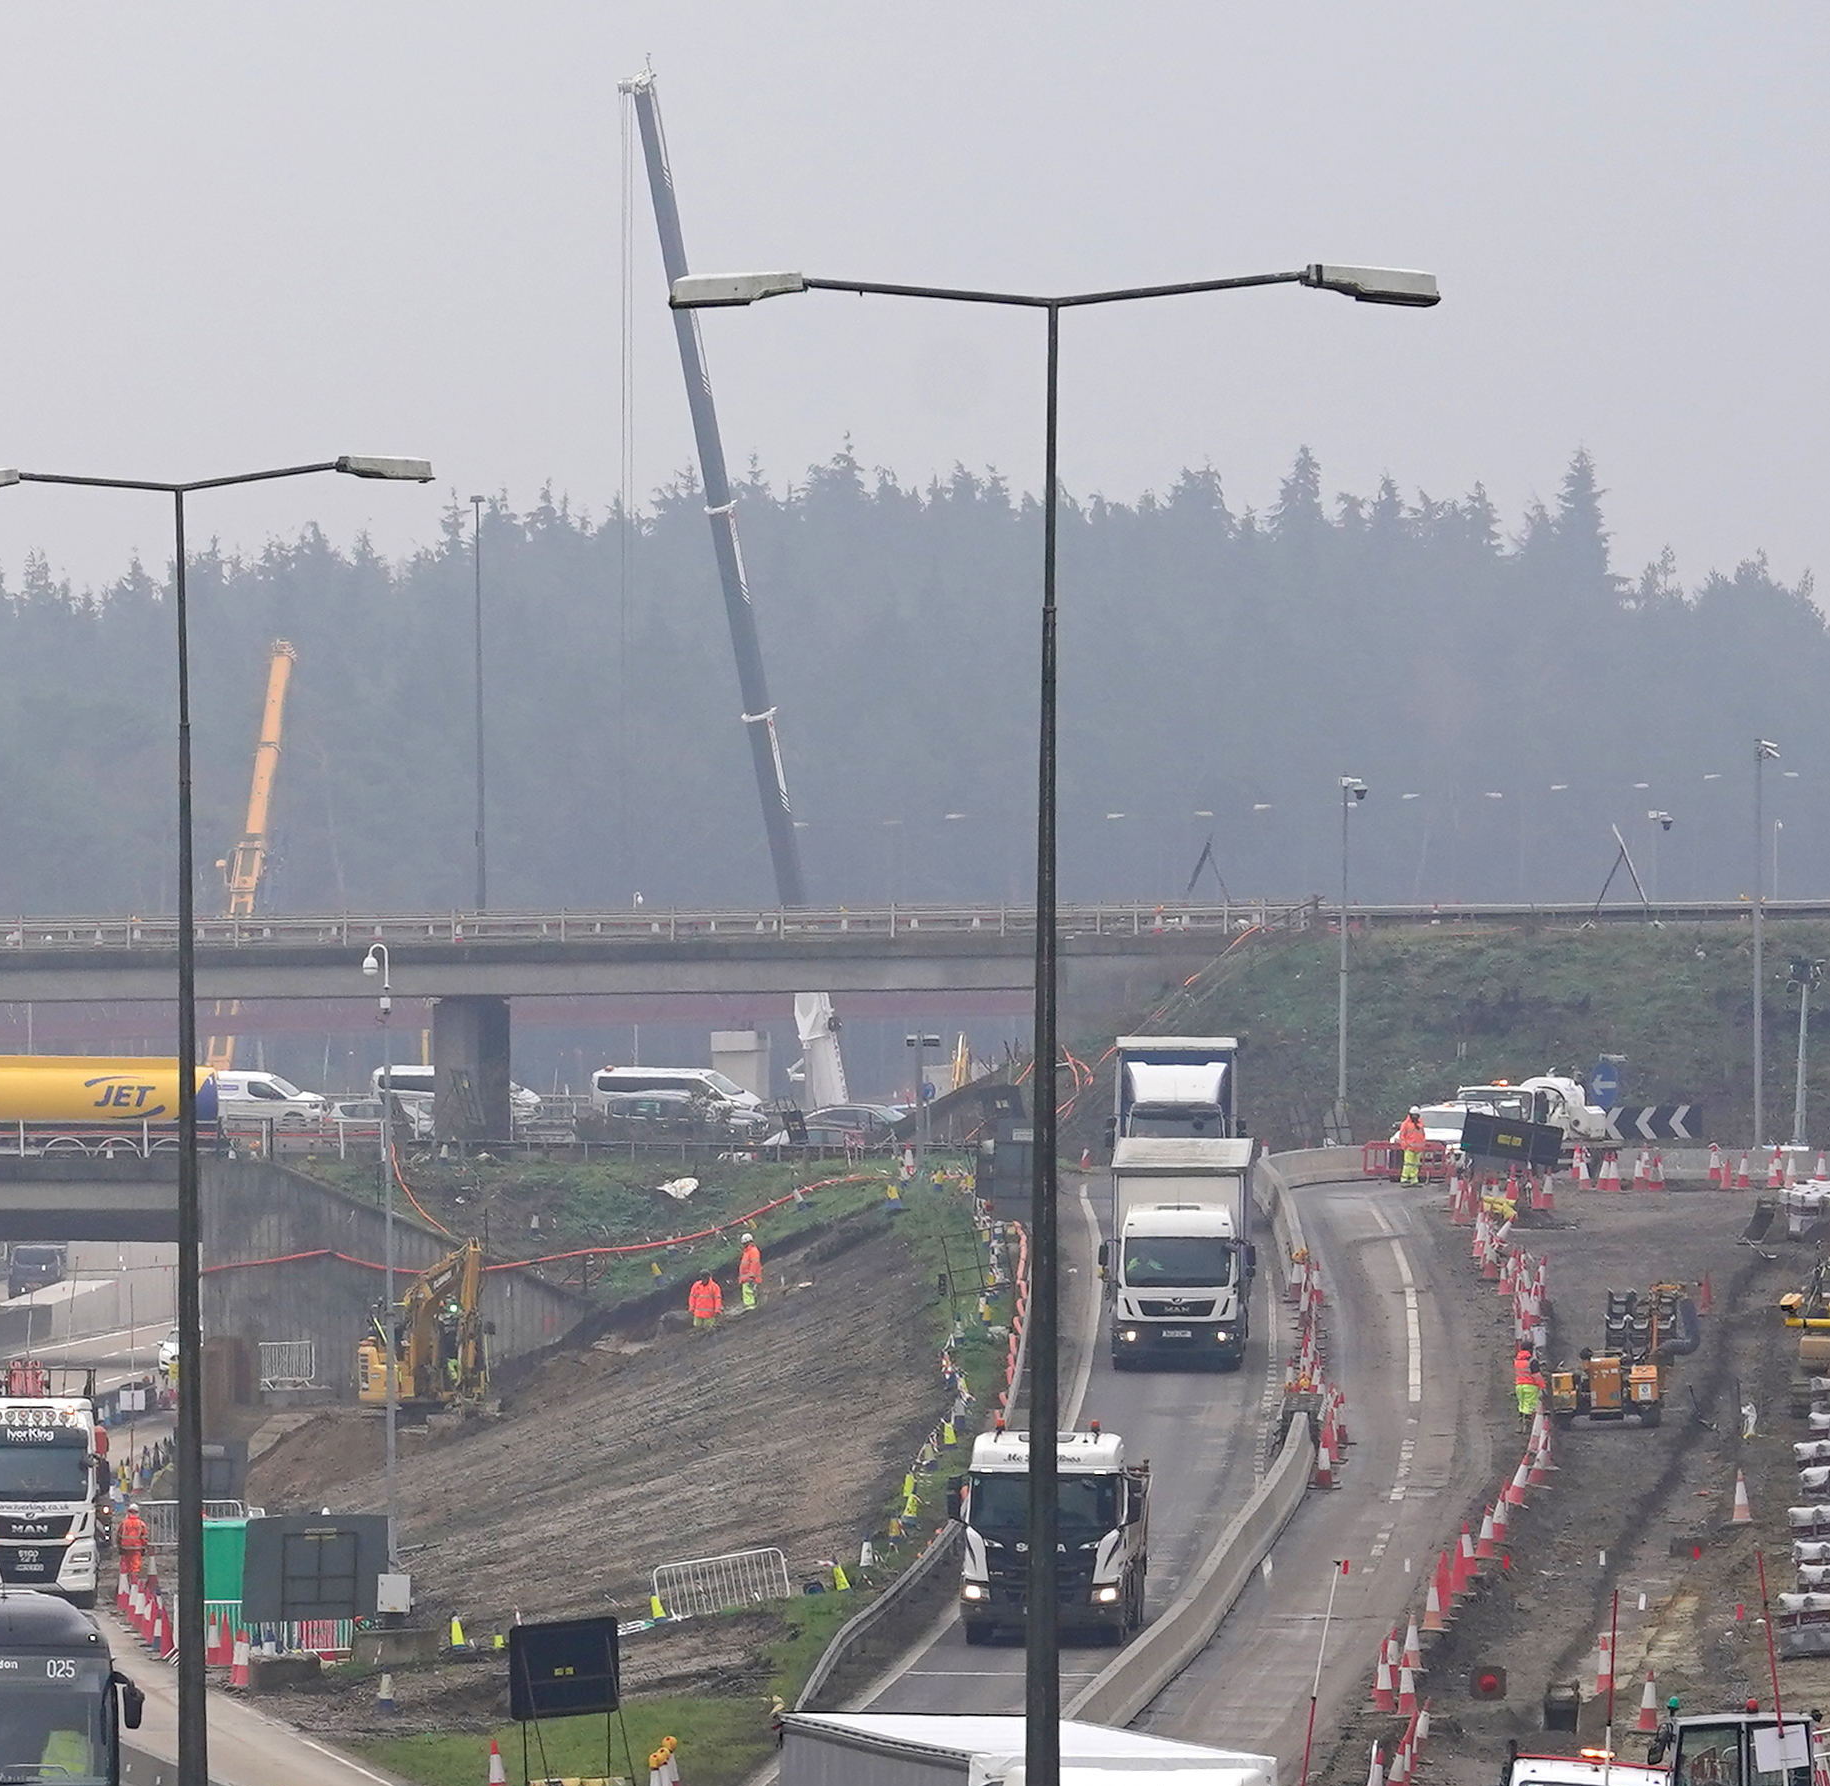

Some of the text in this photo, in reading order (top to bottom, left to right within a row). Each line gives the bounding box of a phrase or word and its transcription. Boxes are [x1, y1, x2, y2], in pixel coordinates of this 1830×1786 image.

[93, 1085, 156, 1107] JET
[11, 1524, 49, 1533] MAN
[46, 1659, 76, 1678] 025
